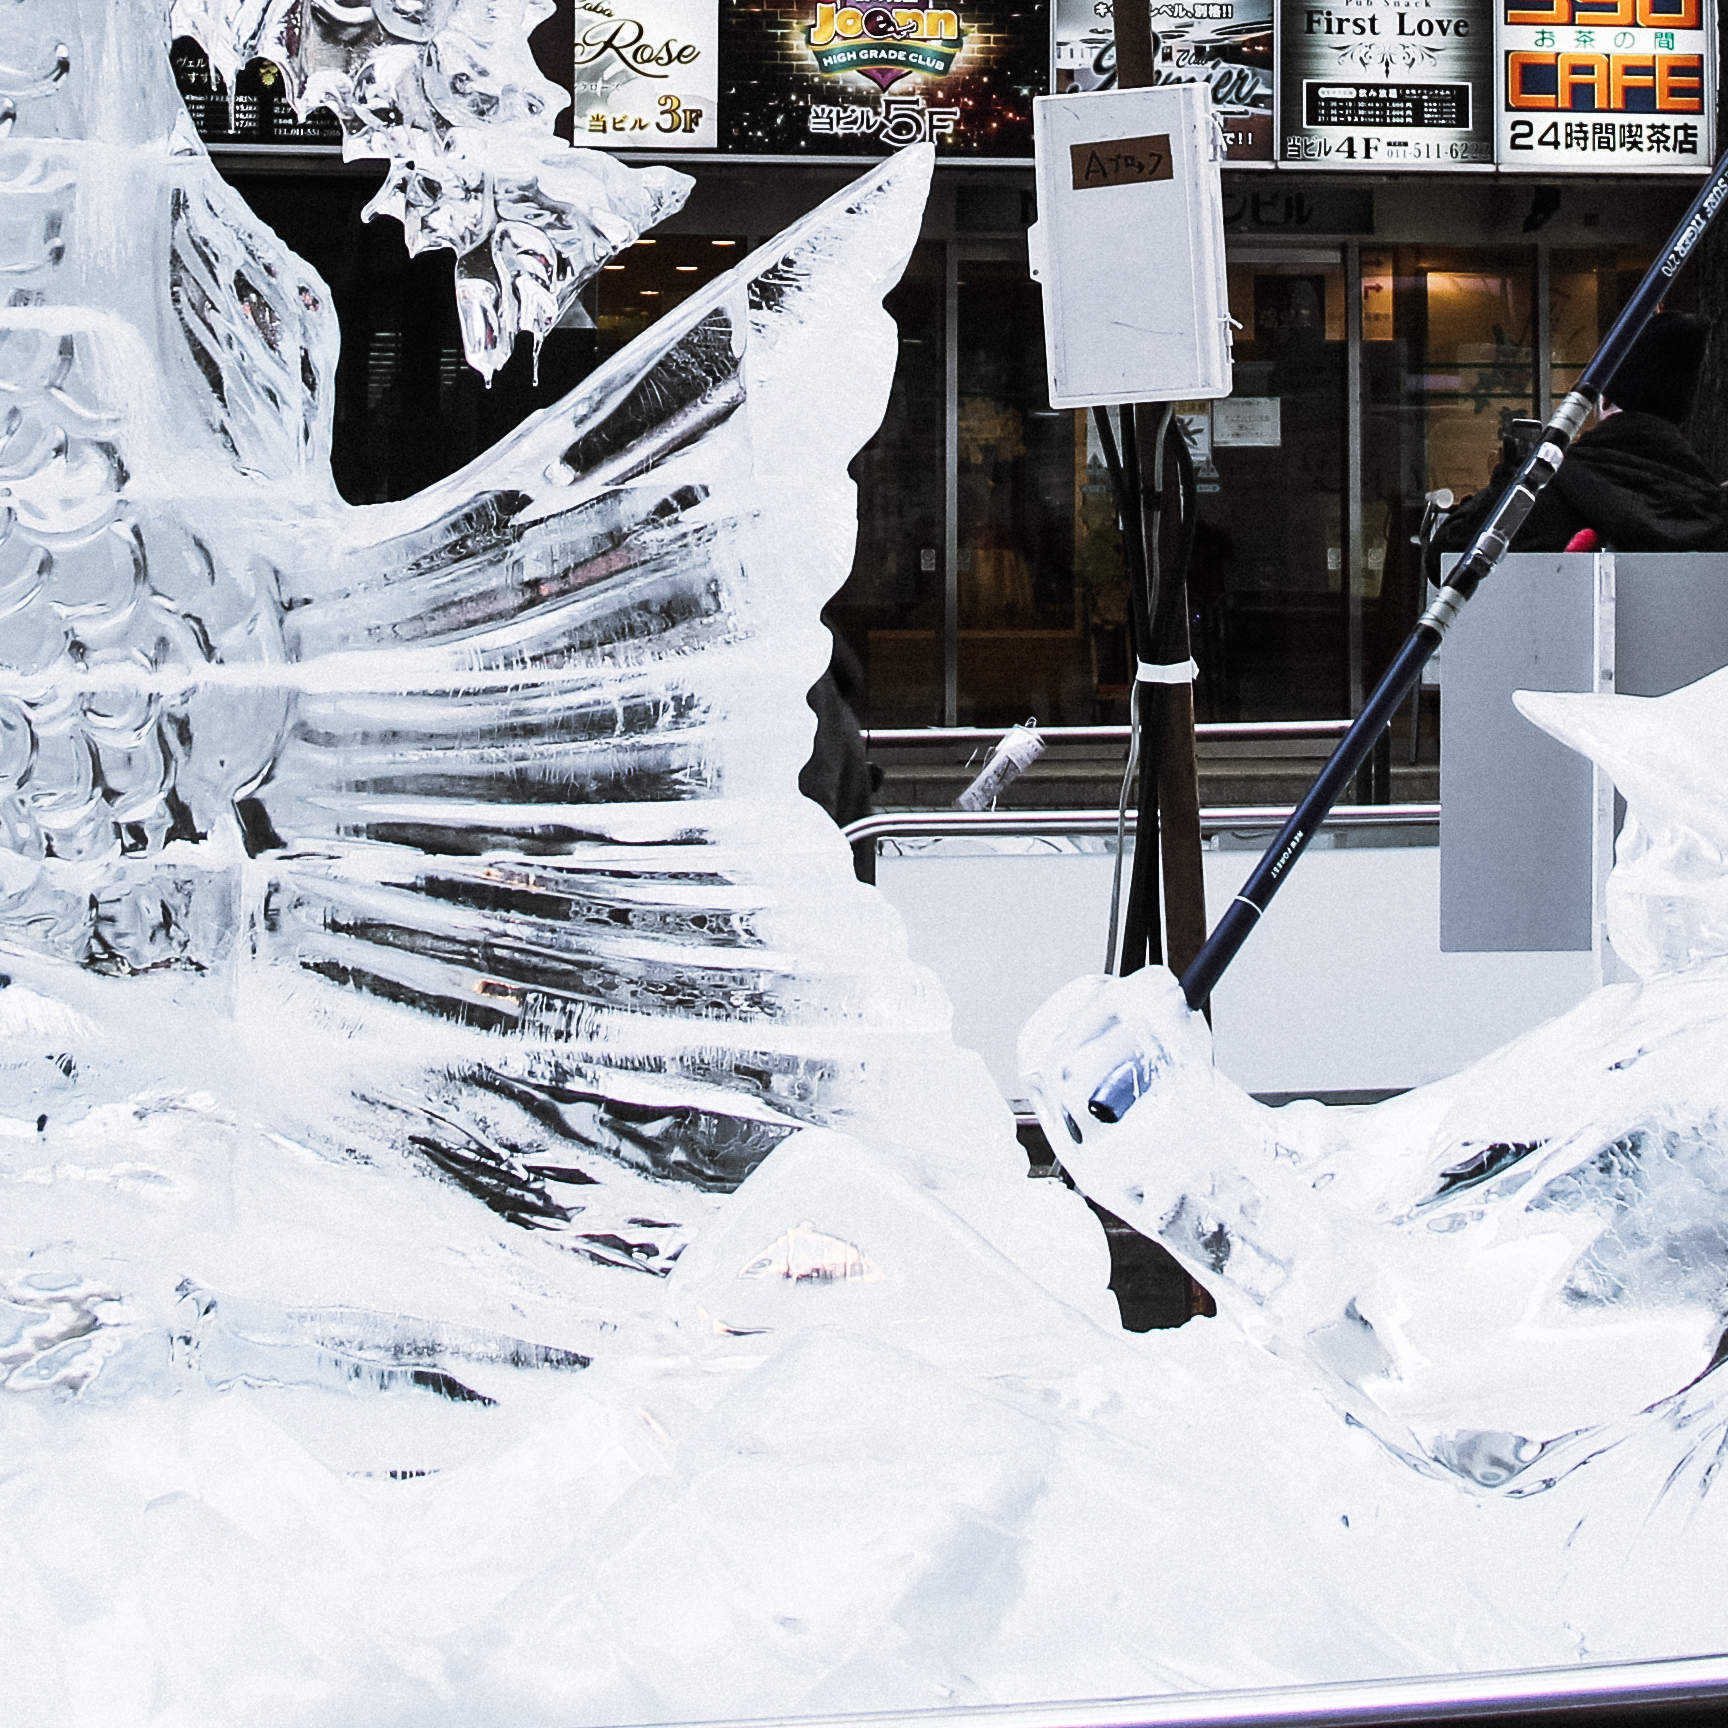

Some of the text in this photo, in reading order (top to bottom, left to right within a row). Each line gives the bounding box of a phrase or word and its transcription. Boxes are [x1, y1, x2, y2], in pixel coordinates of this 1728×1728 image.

[1305, 10, 1471, 38] First Love
[1534, 30, 1676, 50] お茶の間
[574, 18, 702, 79] Rose
[823, 49, 946, 72] HIGH GRADE CLUB
[1508, 51, 1703, 110] CAFE
[588, 94, 703, 134] 当ビル 3F
[809, 96, 960, 147] 当ビル 5F
[1287, 136, 1332, 159] 当ビル
[1335, 136, 1381, 160] 4F
[1509, 119, 1699, 155] 24時間喫茶店
